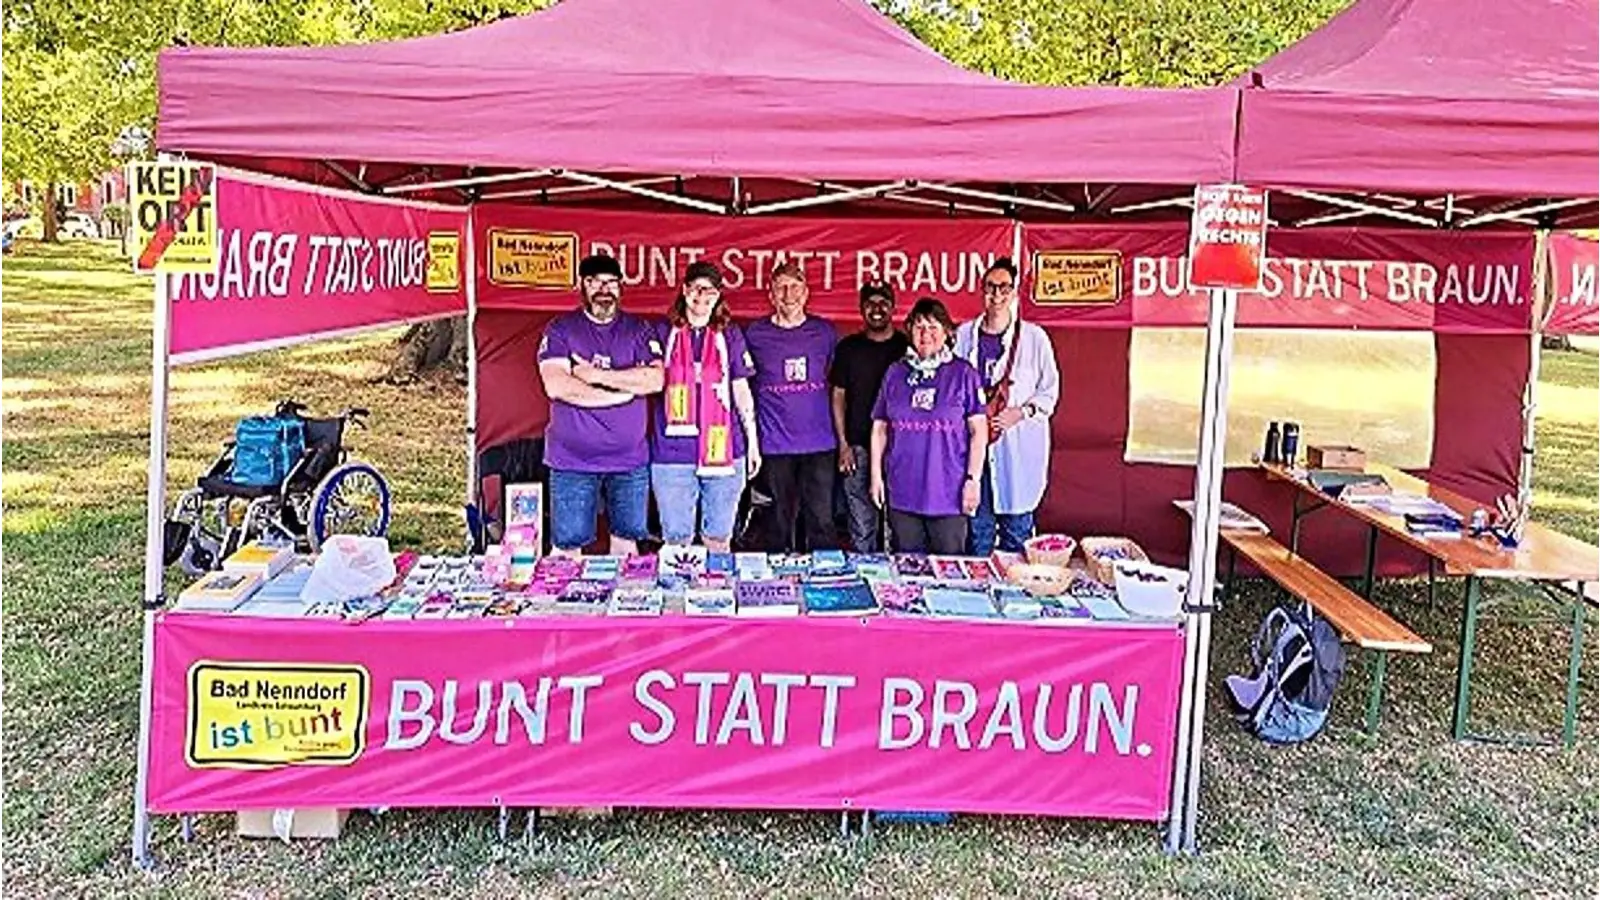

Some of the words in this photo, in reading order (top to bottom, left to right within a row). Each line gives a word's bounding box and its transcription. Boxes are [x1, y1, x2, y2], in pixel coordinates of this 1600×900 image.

[136, 166, 213, 195] KEIN
[138, 200, 211, 232] ORT
[1262, 257, 1373, 299] STATT
[1386, 261, 1524, 304] BRAUN.
[210, 679, 249, 698] Bad
[256, 680, 347, 700] Nenndorf
[211, 719, 253, 749] ist
[264, 706, 342, 741] bunt
[383, 677, 605, 751] BUNT
[629, 669, 856, 748] STATT
[878, 677, 1153, 757] BRAUN.
